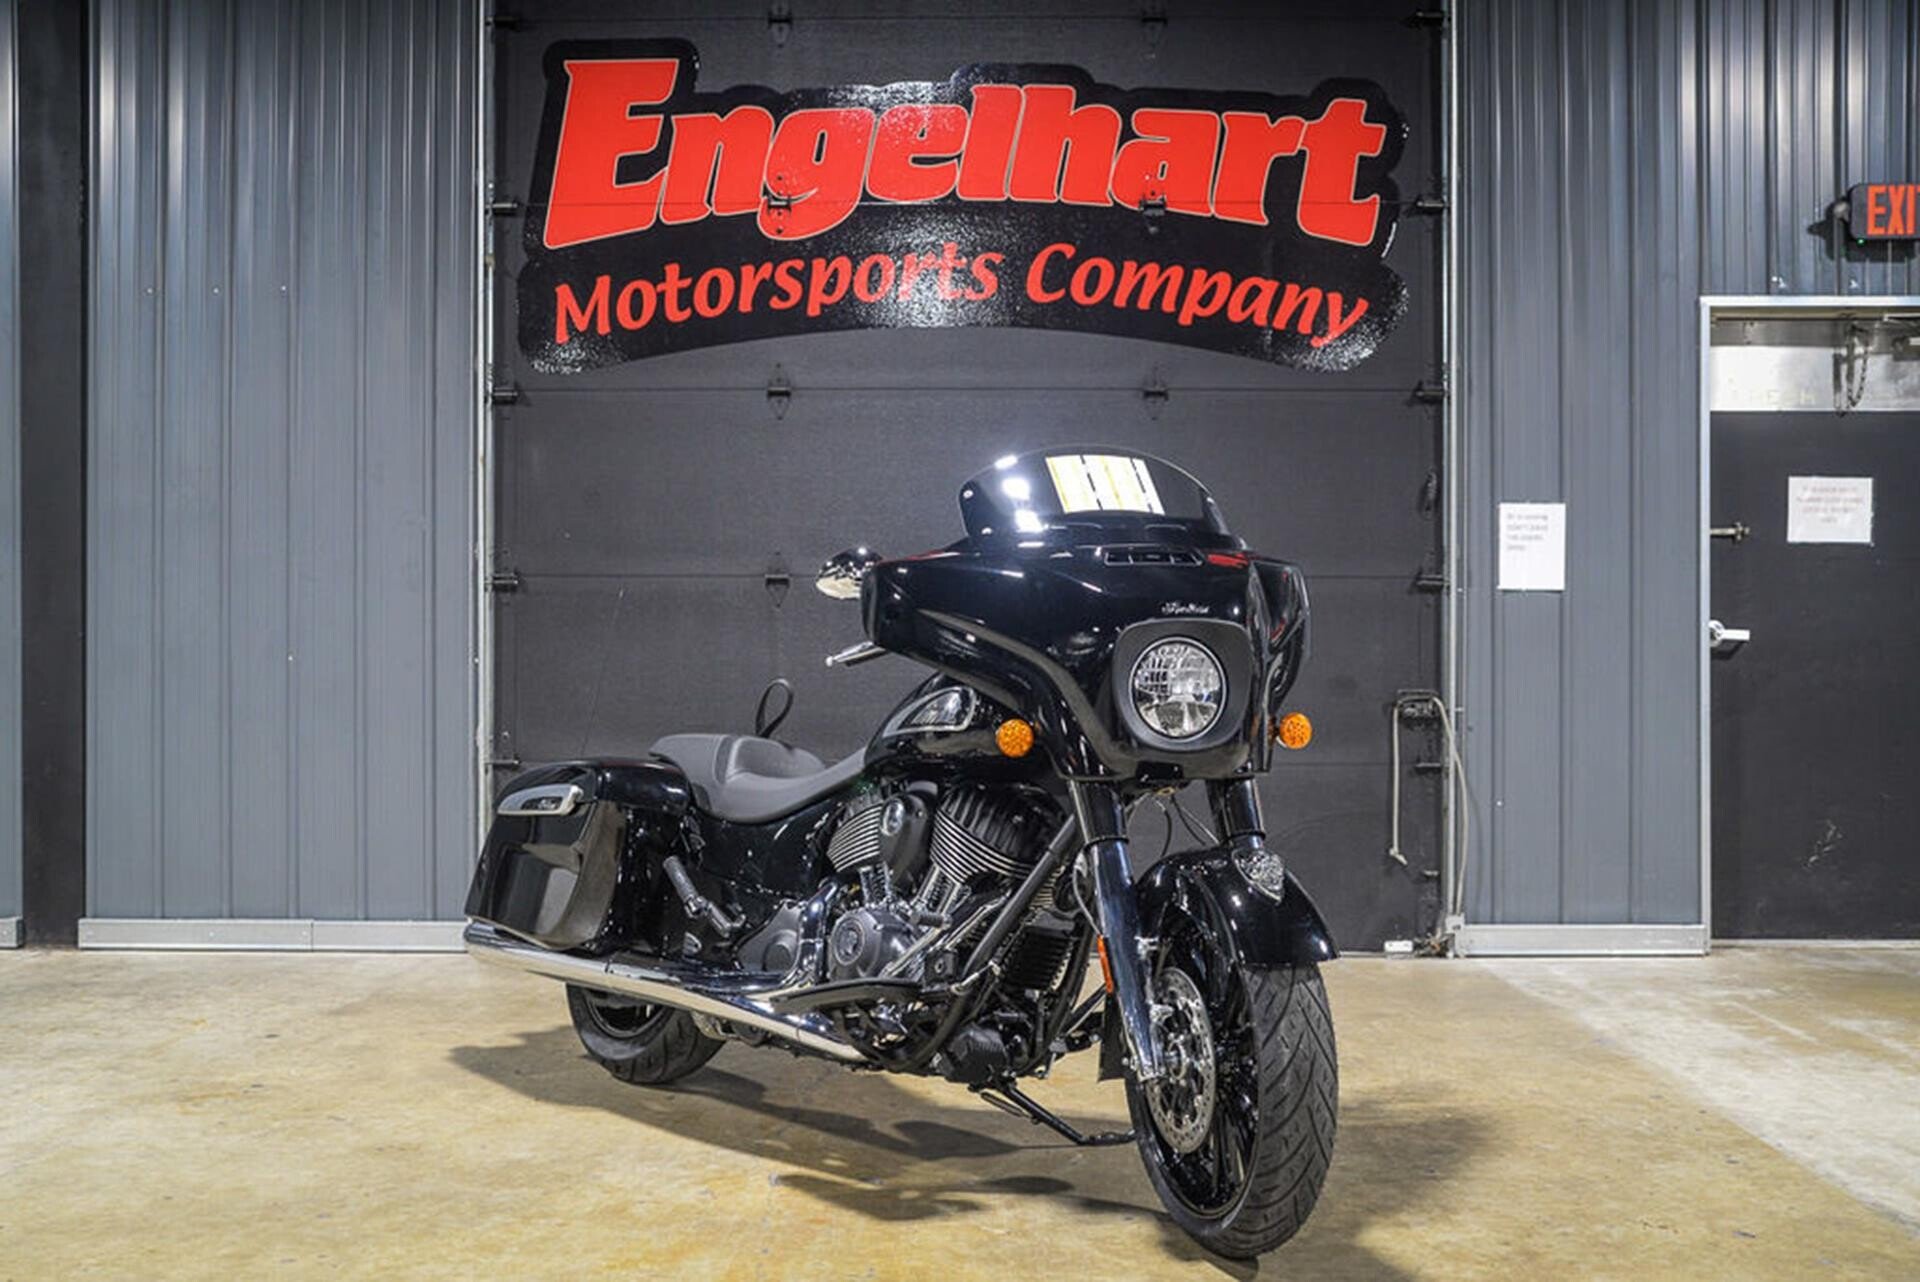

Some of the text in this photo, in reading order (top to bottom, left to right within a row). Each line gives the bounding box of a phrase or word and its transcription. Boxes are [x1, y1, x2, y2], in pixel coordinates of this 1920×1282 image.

[544, 59, 1386, 249] Engelhart
[1867, 184, 1920, 235] EXI
[555, 242, 1369, 347] Motorsports Company
